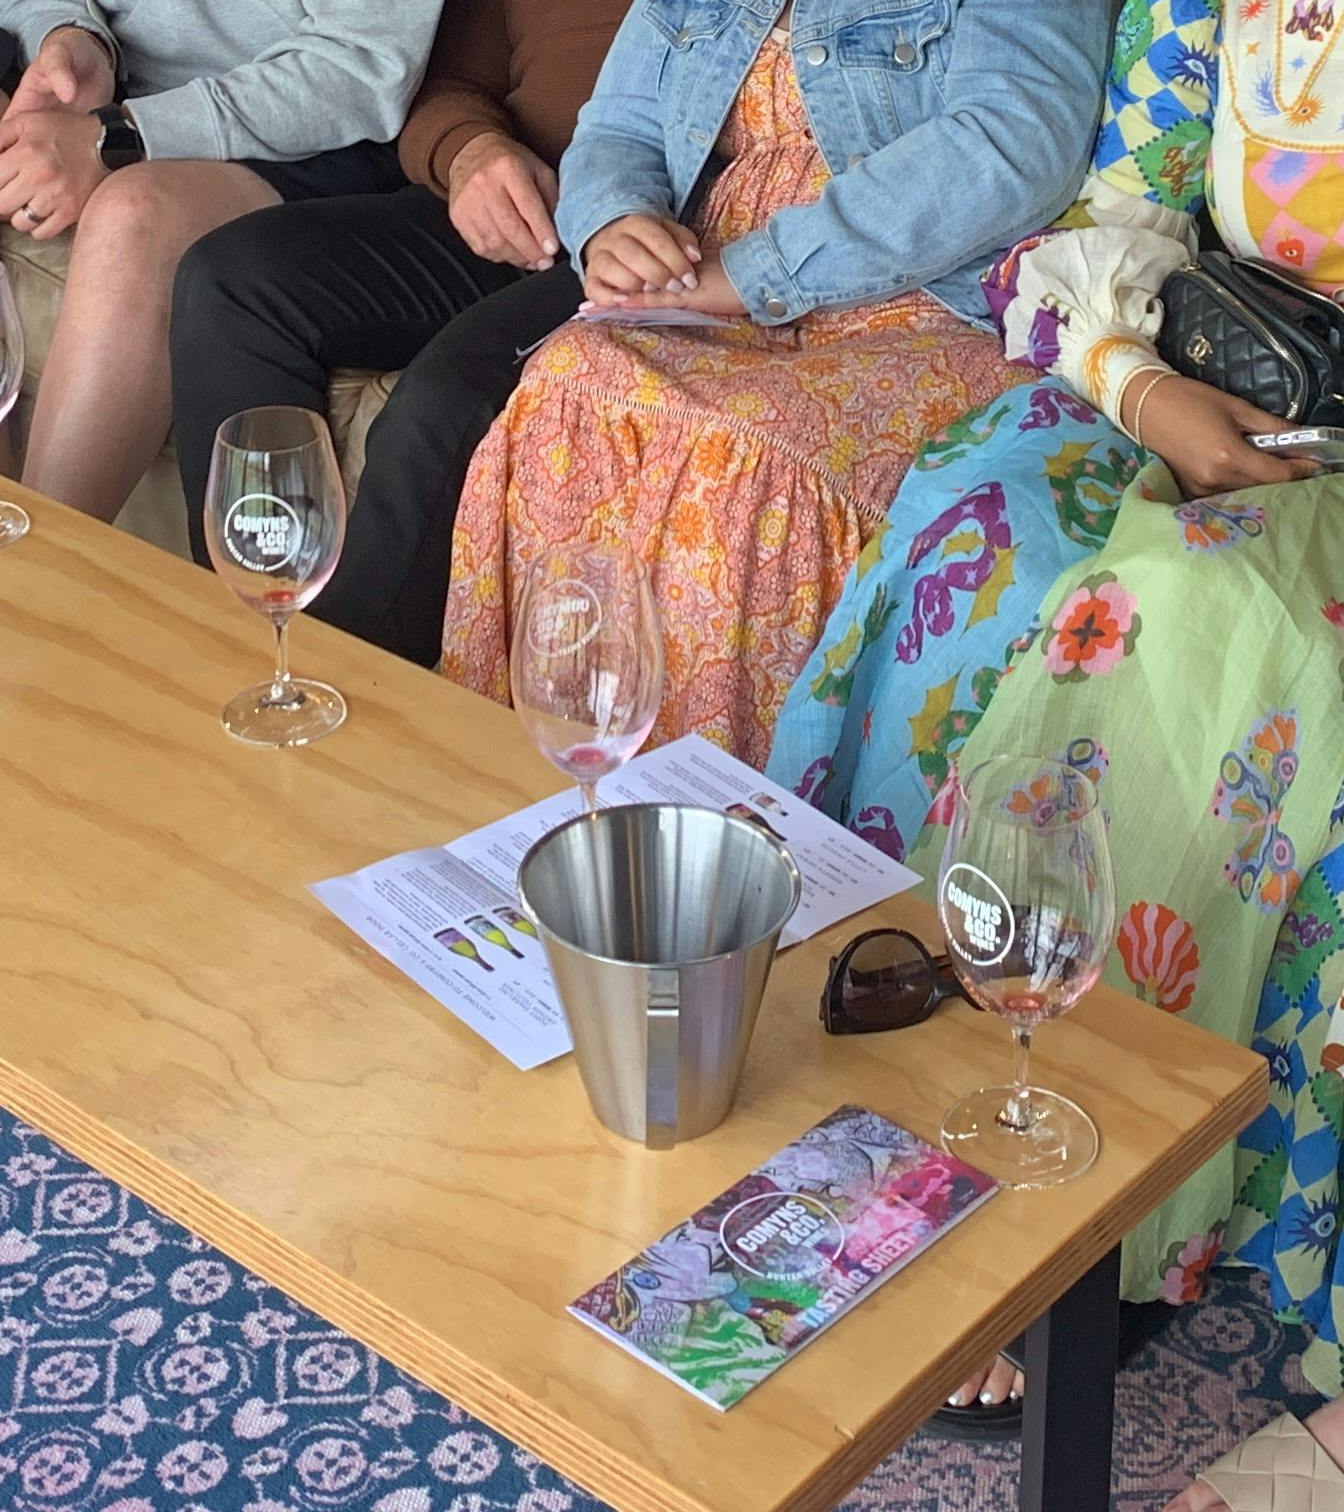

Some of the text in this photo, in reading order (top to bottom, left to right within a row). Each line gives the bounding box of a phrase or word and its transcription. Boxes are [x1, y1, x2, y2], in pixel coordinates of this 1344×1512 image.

[233, 513, 289, 533] COMYNS
[947, 881, 1002, 926] COMYNS
[964, 913, 1001, 944] &CO.
[736, 1200, 807, 1252] COMYNS
[780, 1217, 826, 1246] &CO.
[797, 1230, 916, 1328] TASTING SHEET
